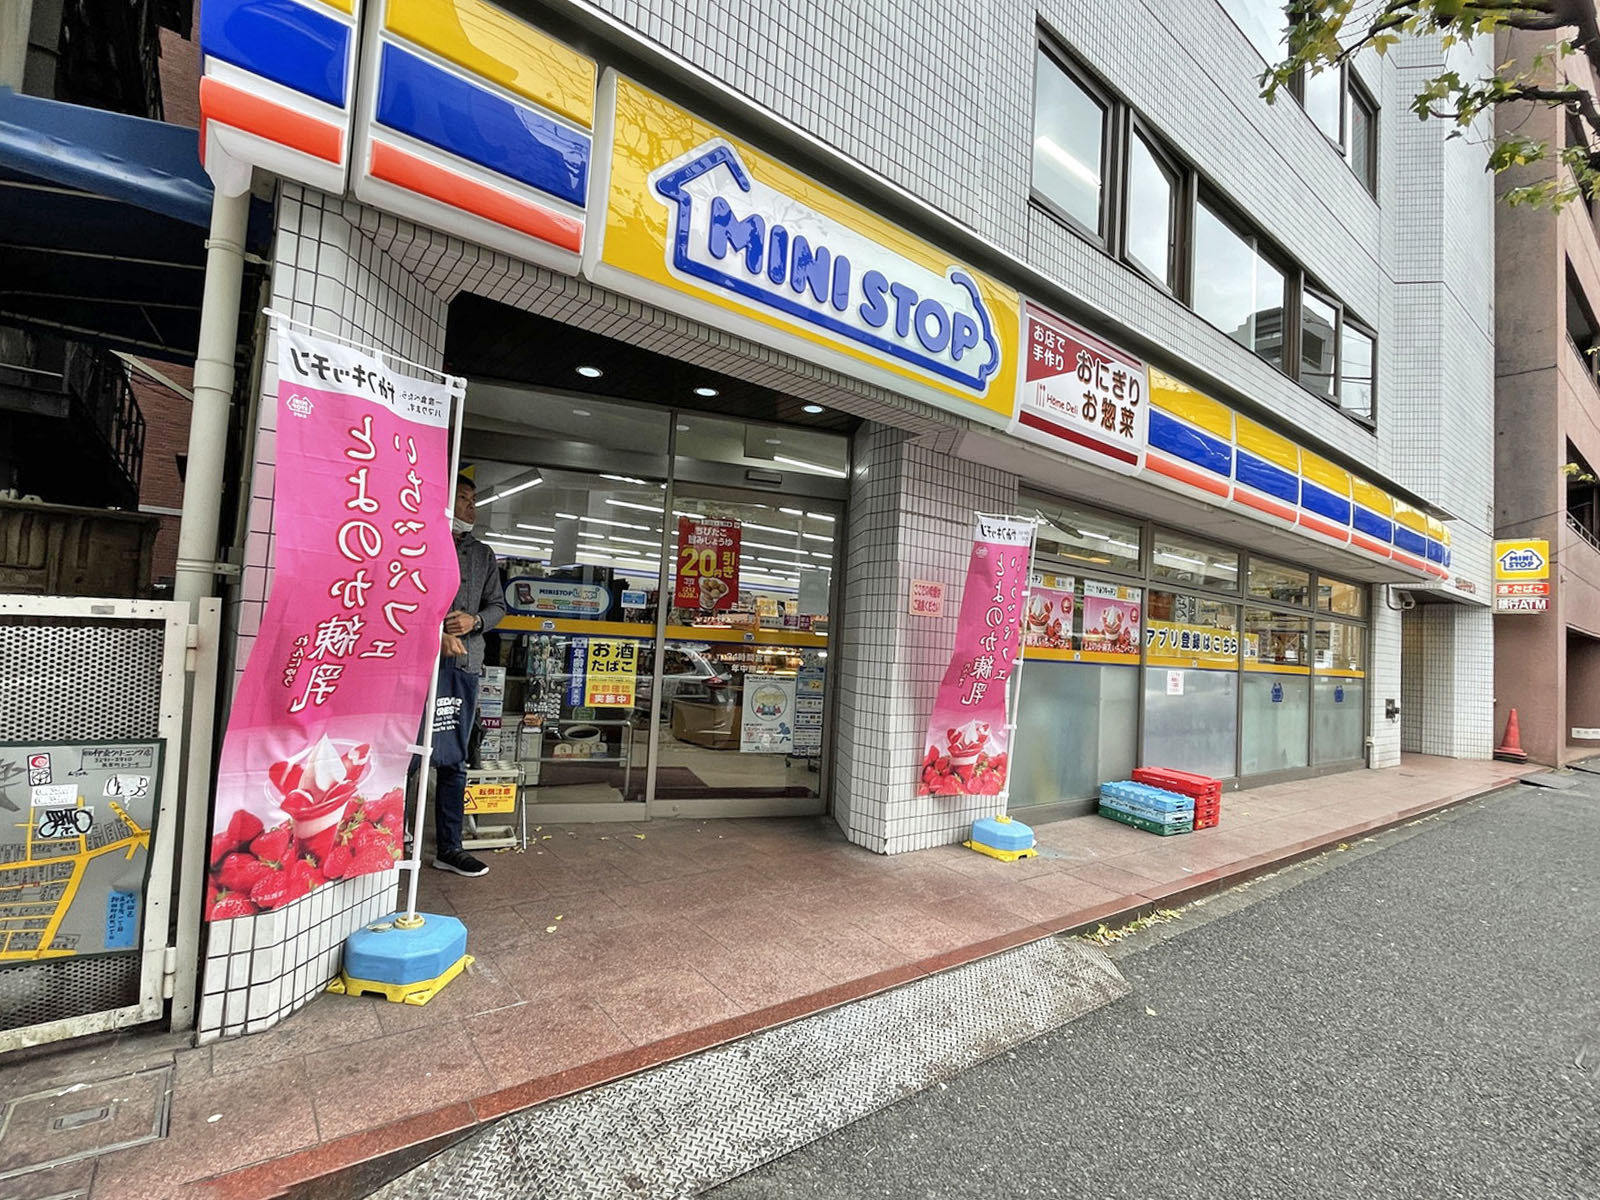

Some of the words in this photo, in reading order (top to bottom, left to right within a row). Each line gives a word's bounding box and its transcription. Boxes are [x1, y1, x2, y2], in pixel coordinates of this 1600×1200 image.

[708, 196, 851, 312] MINI
[859, 270, 979, 362] STOP
[1032, 324, 1066, 353] お店で
[1032, 344, 1065, 371] 手作り
[1076, 350, 1141, 407] おにぎり
[1046, 393, 1066, 410] Home
[1065, 400, 1079, 416] Deli
[1081, 389, 1136, 439] お惣菜
[1498, 599, 1547, 610] 銀行ATM
[592, 642, 634, 659] お酒
[1146, 628, 1239, 655] アプリ登録はこちら
[591, 659, 633, 673] たばこ
[481, 718, 500, 727] ATM
